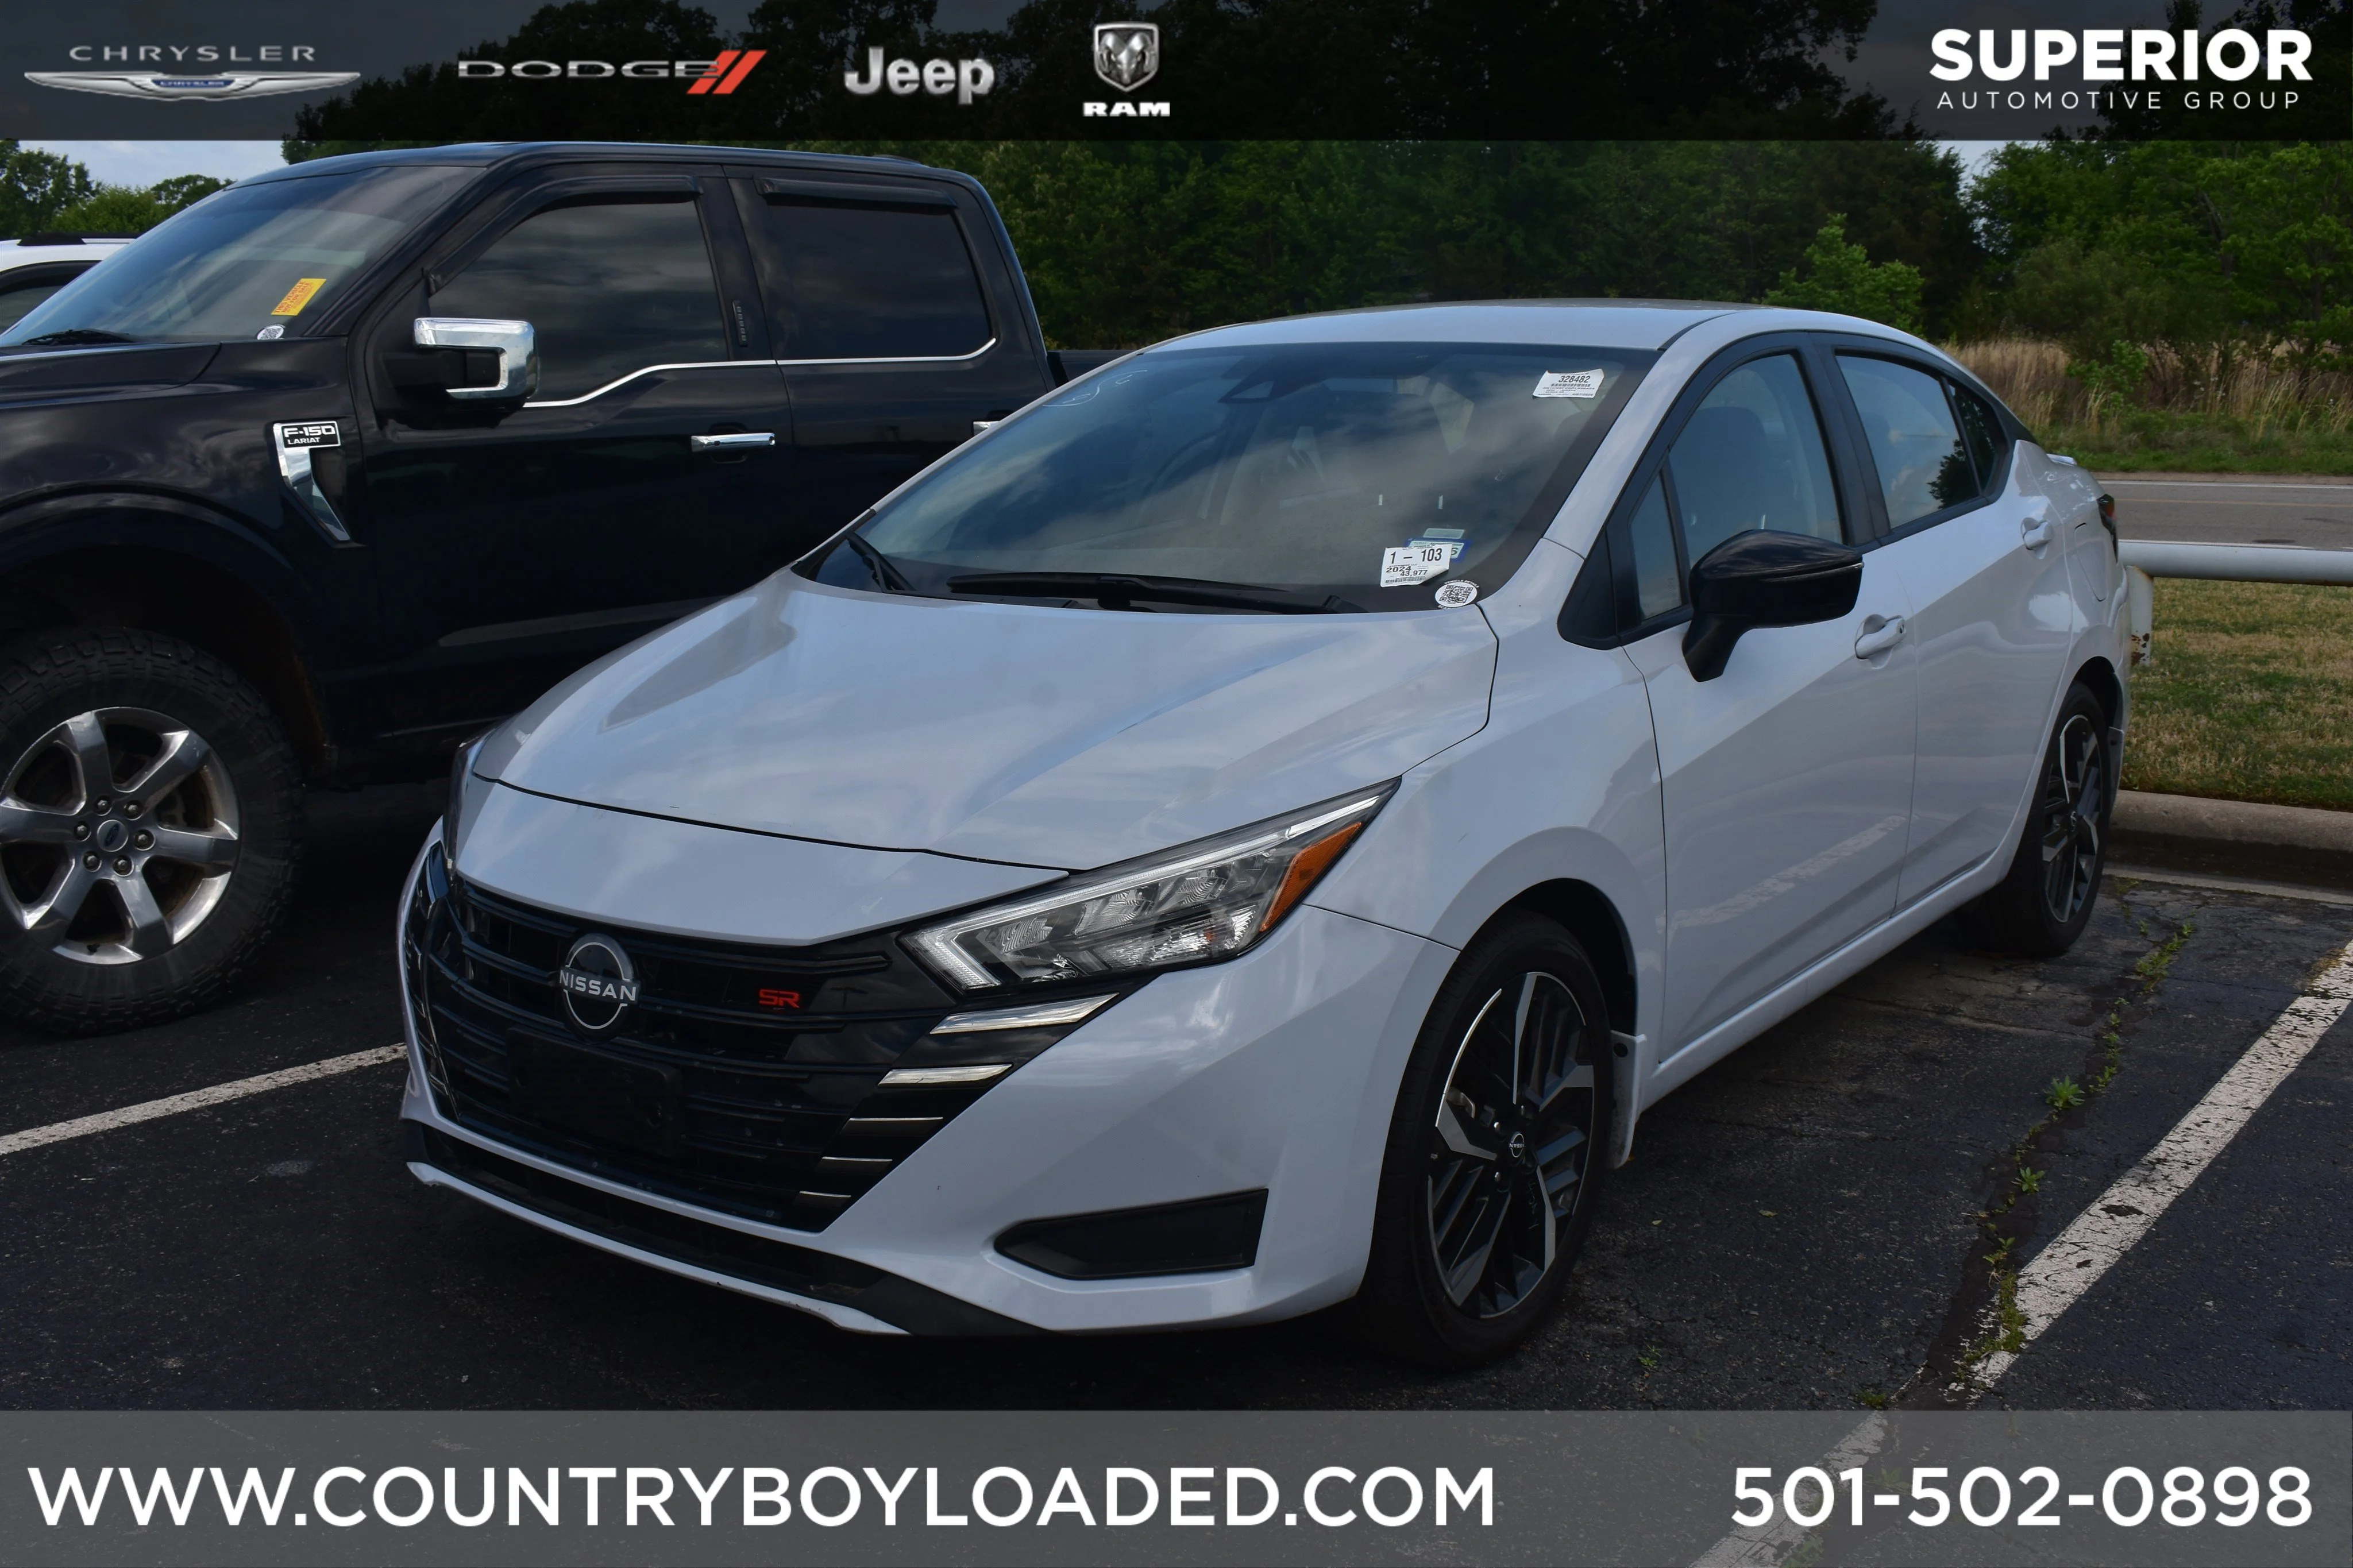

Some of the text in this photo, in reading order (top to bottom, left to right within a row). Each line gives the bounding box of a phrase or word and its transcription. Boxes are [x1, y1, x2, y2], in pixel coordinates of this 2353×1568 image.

[1558, 375, 1591, 383] 328482
[284, 425, 335, 438] F-150
[287, 437, 321, 445] LARIAT
[1390, 551, 1397, 565] 1
[1421, 548, 1442, 562] 103
[559, 969, 637, 1001] NISSAN
[758, 988, 800, 1009] SR
